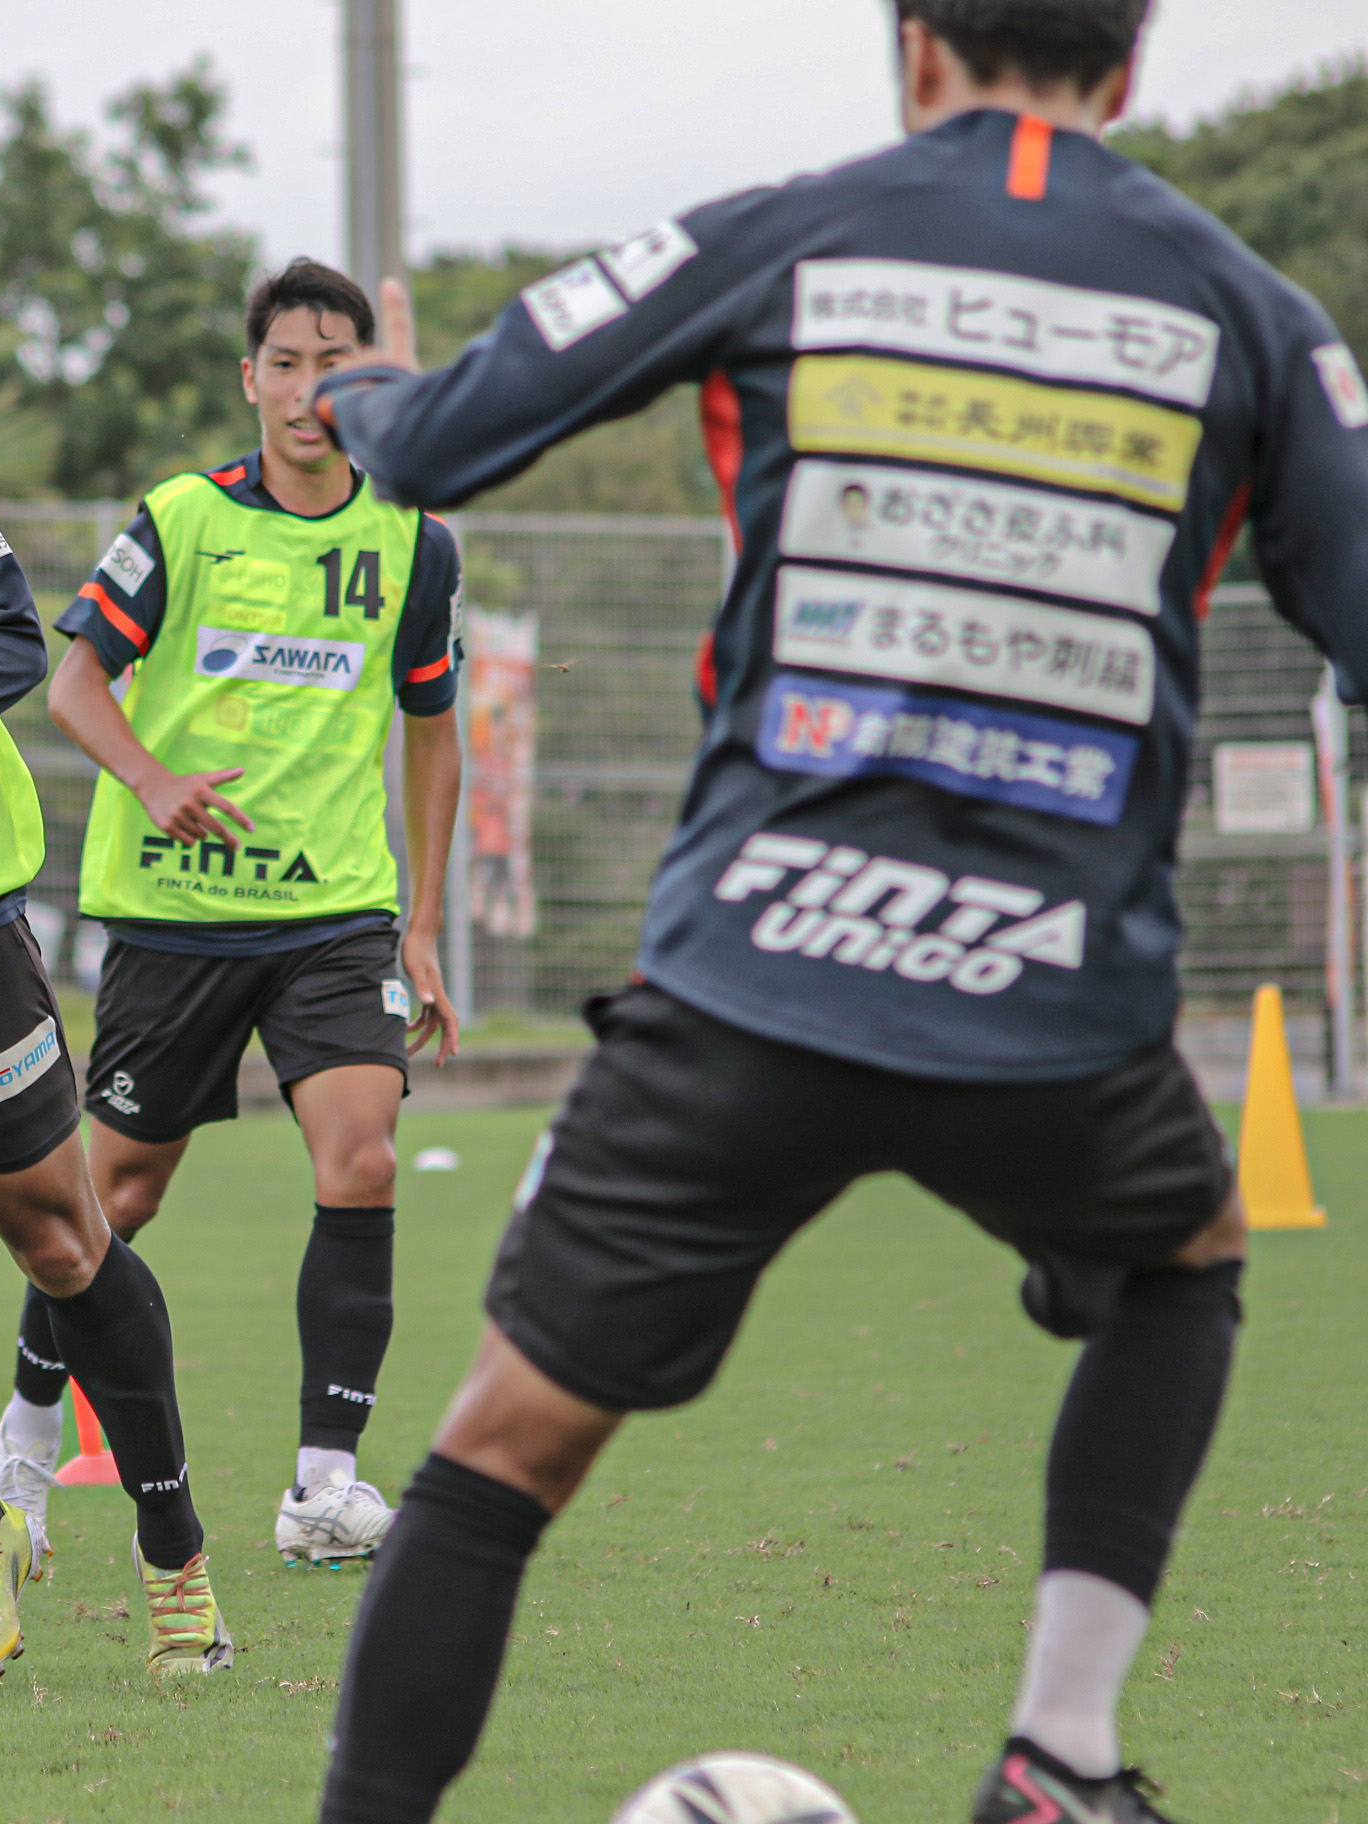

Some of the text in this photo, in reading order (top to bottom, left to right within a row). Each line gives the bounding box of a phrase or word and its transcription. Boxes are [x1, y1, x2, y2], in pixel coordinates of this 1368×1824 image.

[947, 286, 1208, 377] ヒューモア
[316, 547, 386, 621] 14
[252, 644, 351, 674] SAWATA
[157, 877, 299, 902] FINTA do BRASIL
[327, 1383, 377, 1406] FINT
